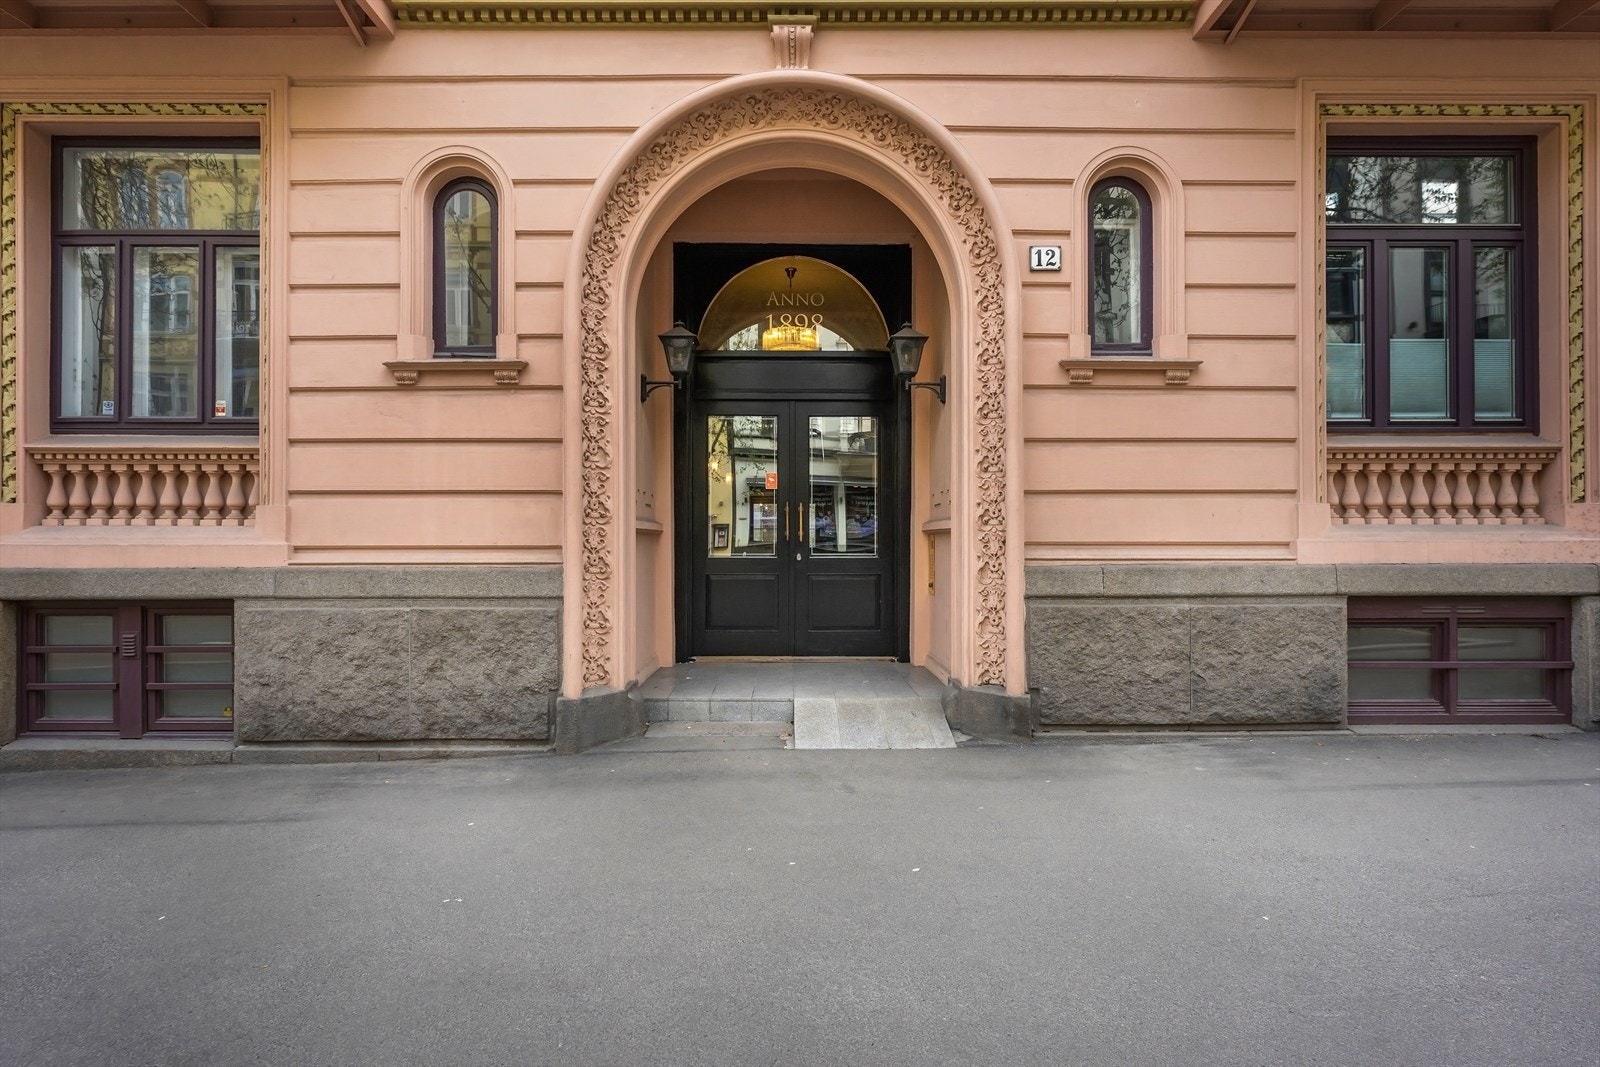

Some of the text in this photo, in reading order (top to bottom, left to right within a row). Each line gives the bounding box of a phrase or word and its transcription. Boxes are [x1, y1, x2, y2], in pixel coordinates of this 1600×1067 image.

[1034, 249, 1057, 267] 12
[766, 291, 825, 307] ANNO
[765, 313, 824, 331] 1898
